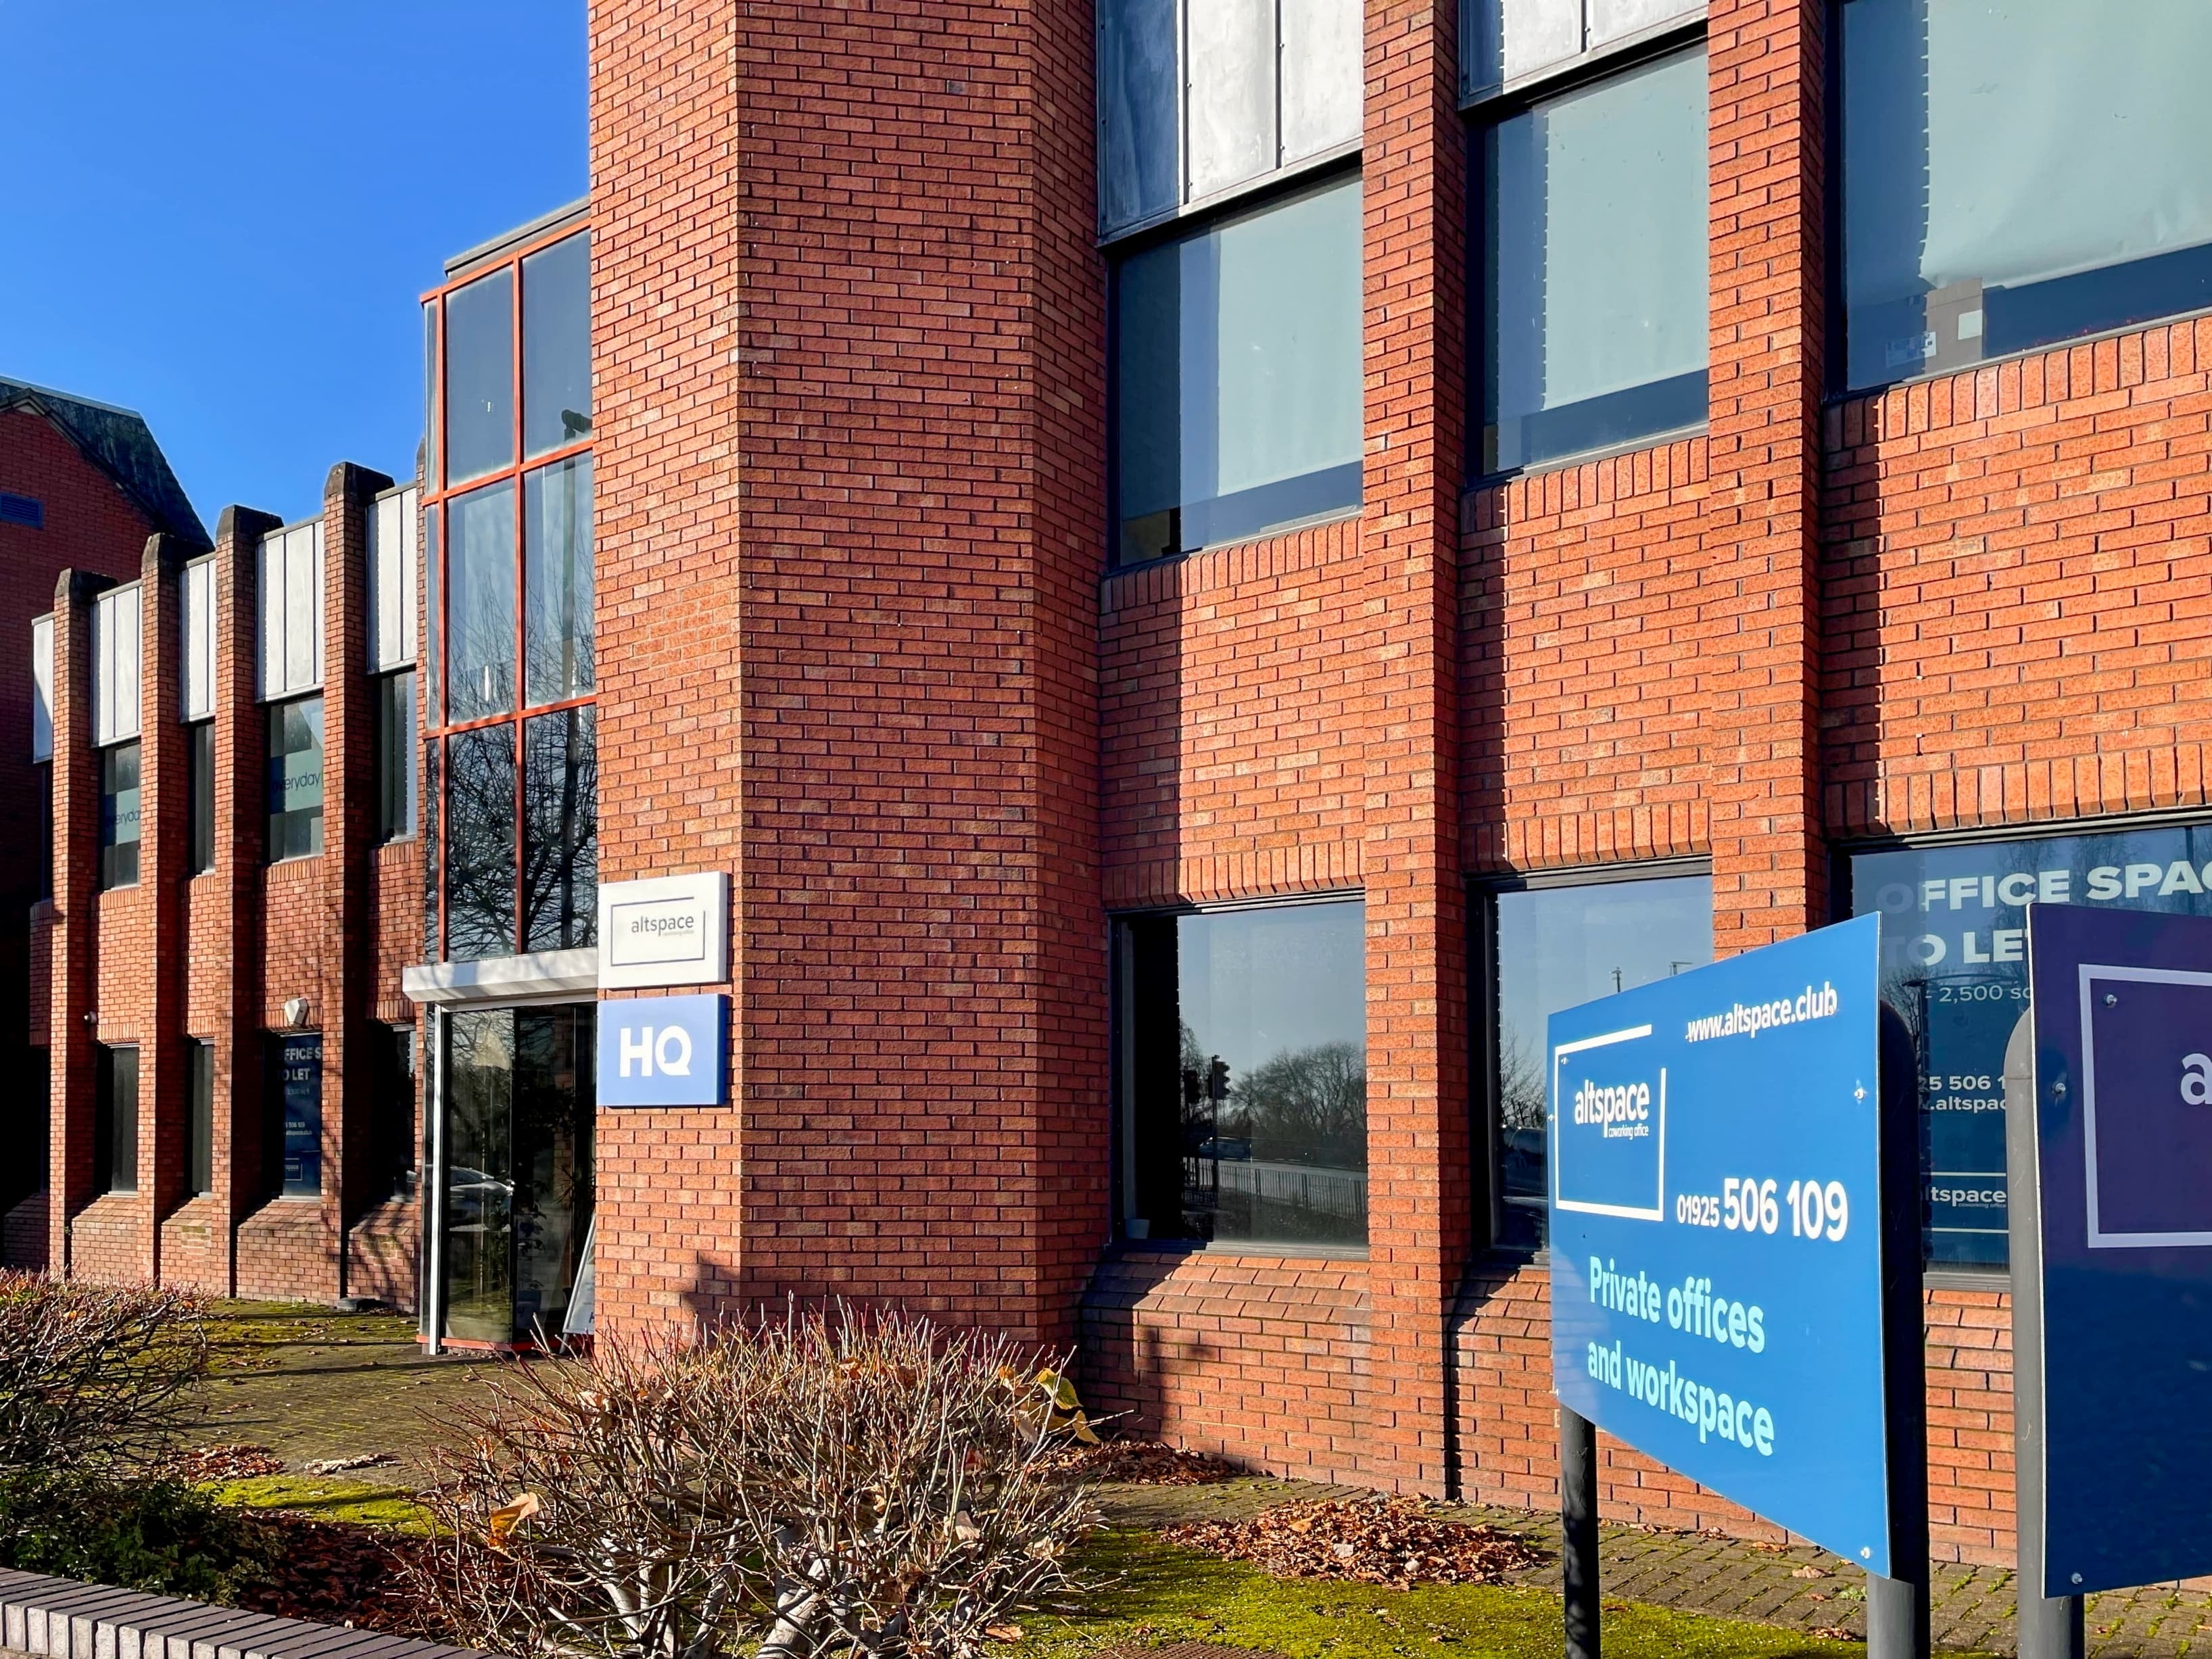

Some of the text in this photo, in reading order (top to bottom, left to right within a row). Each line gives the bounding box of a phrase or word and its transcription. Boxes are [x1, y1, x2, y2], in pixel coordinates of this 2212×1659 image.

[1875, 869, 2070, 913] OFFICE
[631, 915, 694, 936] altspace
[1963, 928, 2029, 964] LE
[1686, 981, 1838, 1042] www.altspace.club
[1939, 984, 2003, 1005] 2,500
[291, 1067, 310, 1081] LET
[620, 1026, 692, 1077] HQ
[1948, 1075, 1992, 1091] 506
[2180, 1053, 2212, 1105] a
[1574, 1078, 1650, 1138] altspace
[1608, 1122, 1650, 1140] coworking office
[1676, 1177, 1849, 1243] 01925 506 109
[1589, 1255, 1766, 1354] Private offices
[1587, 1339, 1775, 1457] and workspace
